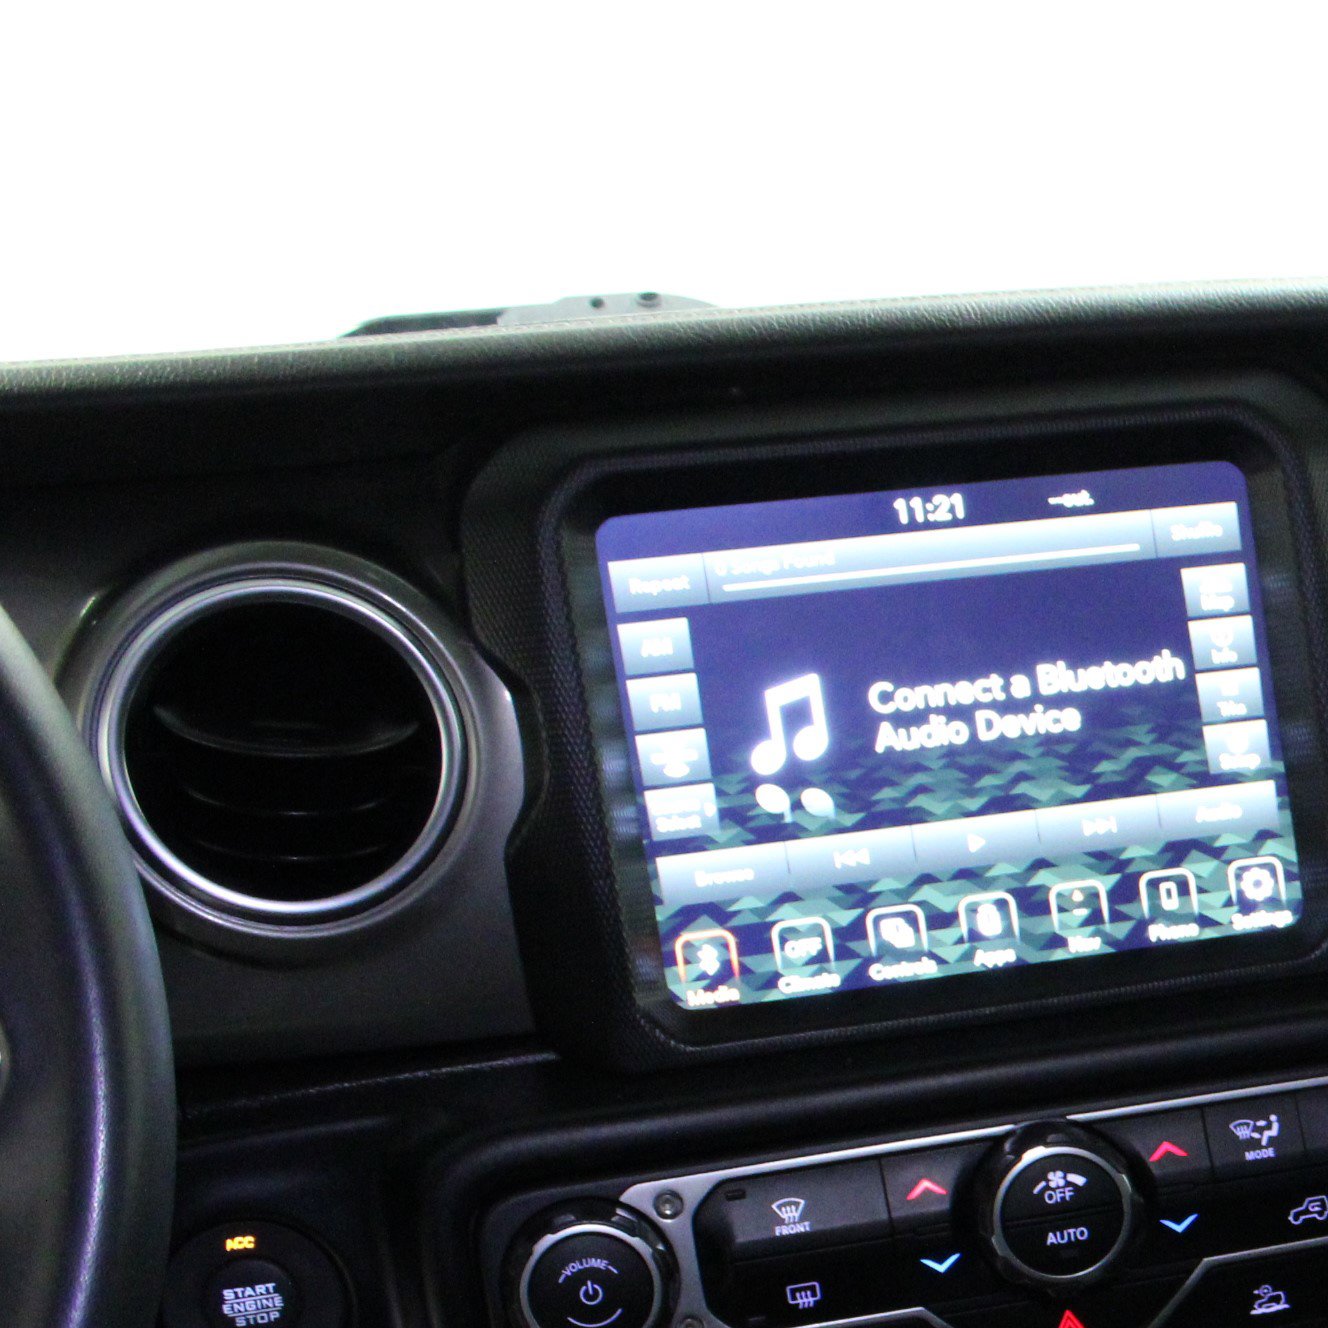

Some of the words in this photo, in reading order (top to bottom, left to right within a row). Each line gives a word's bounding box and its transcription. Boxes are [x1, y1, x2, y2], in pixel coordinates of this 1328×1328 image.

[894, 493, 966, 524] 11:21
[640, 637, 673, 657] AM
[868, 673, 1006, 714] Connect
[1009, 674, 1031, 699] a
[1036, 649, 1186, 695] Bluetooth
[649, 692, 682, 713] FM
[874, 714, 970, 754] Audio
[975, 704, 1082, 742] Device
[1148, 922, 1200, 943] Phone
[868, 956, 939, 982] Controls
[973, 948, 1017, 969] Apps
[777, 971, 841, 994] Climate
[686, 985, 741, 1007] Media
[1244, 1146, 1276, 1161] MODE
[1043, 1186, 1075, 1205] OFF
[774, 1221, 811, 1237] FRONT
[1045, 1226, 1089, 1246] AUTO
[225, 1235, 255, 1252] ACC
[562, 1257, 609, 1278] VOLUME
[223, 1283, 276, 1300] START
[222, 1296, 284, 1315] ENGINE
[235, 1311, 280, 1327] STOP
